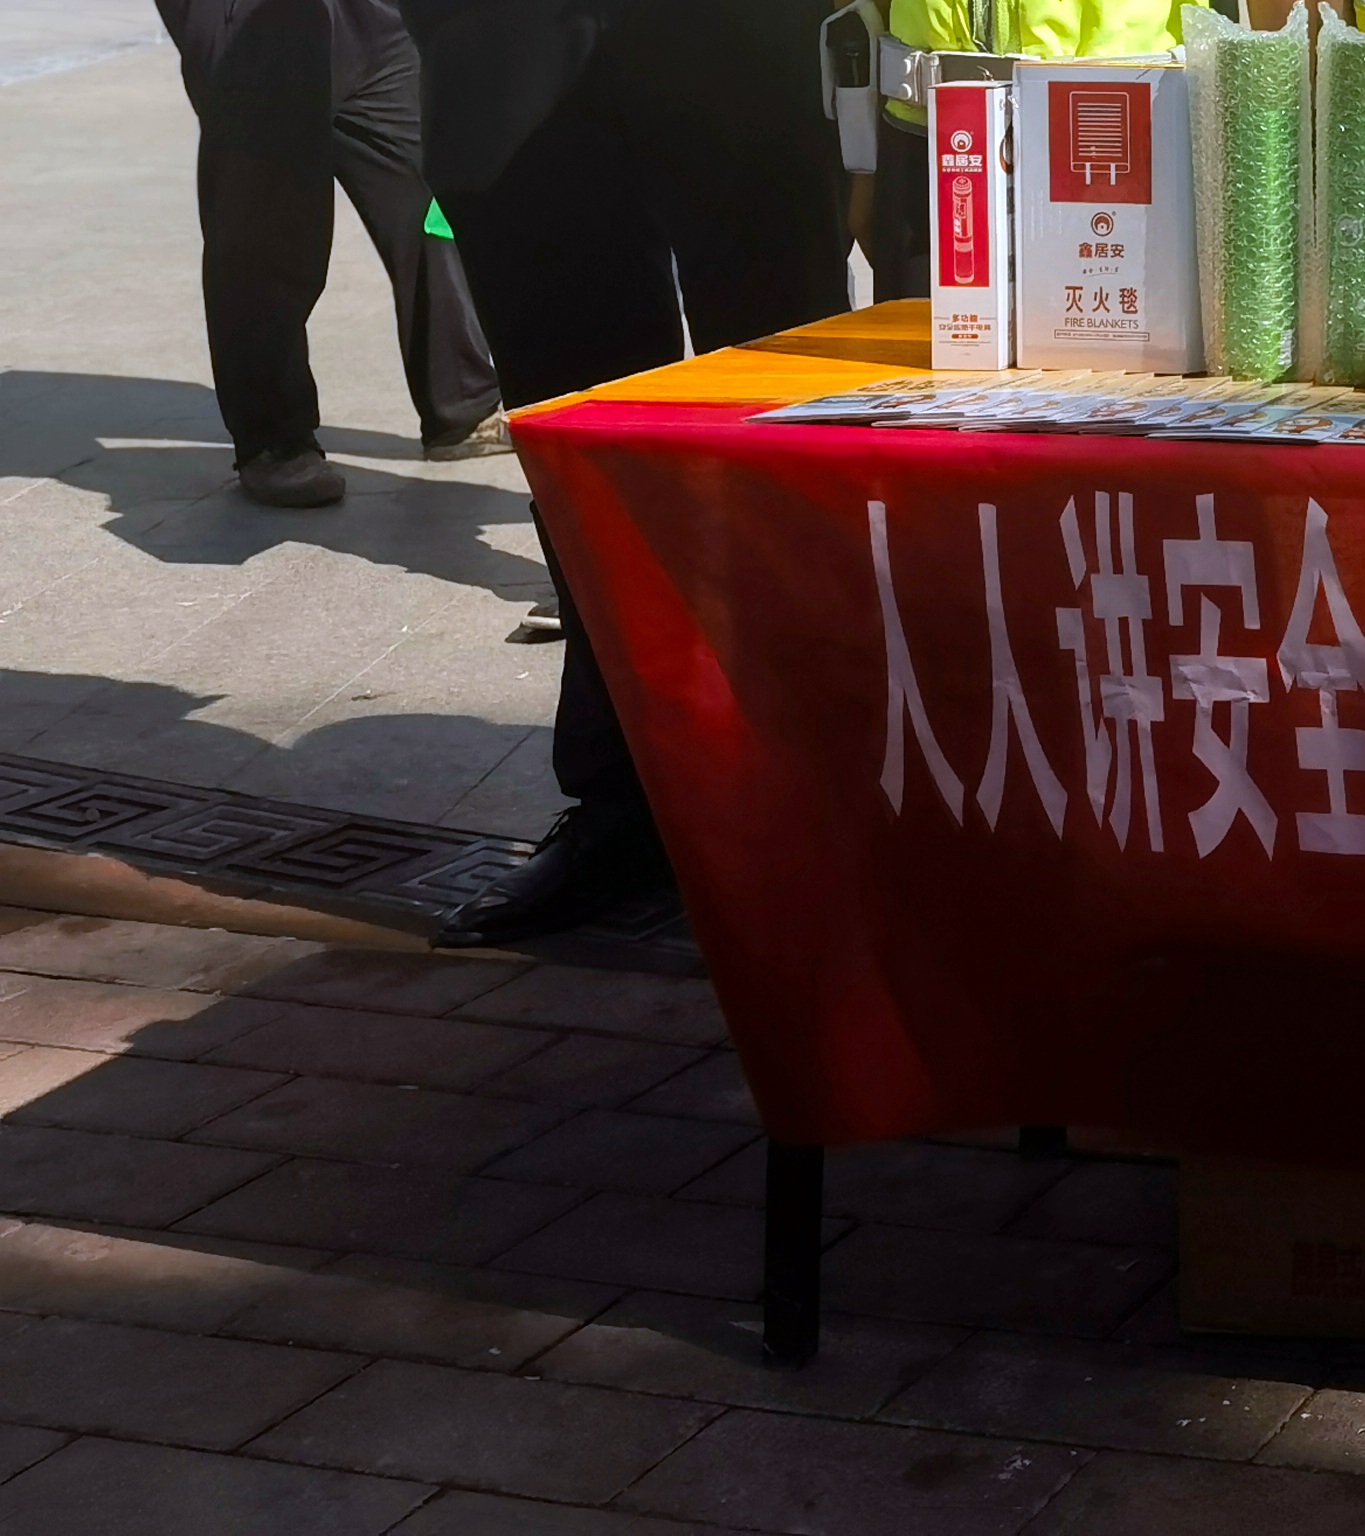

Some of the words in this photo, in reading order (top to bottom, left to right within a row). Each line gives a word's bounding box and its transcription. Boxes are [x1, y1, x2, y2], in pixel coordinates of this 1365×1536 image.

[1078, 242, 1125, 258] 鑫居安
[1064, 286, 1138, 314] 灭火毯
[1064, 317, 1084, 328] FIRE
[1087, 318, 1139, 329] BLANKETS
